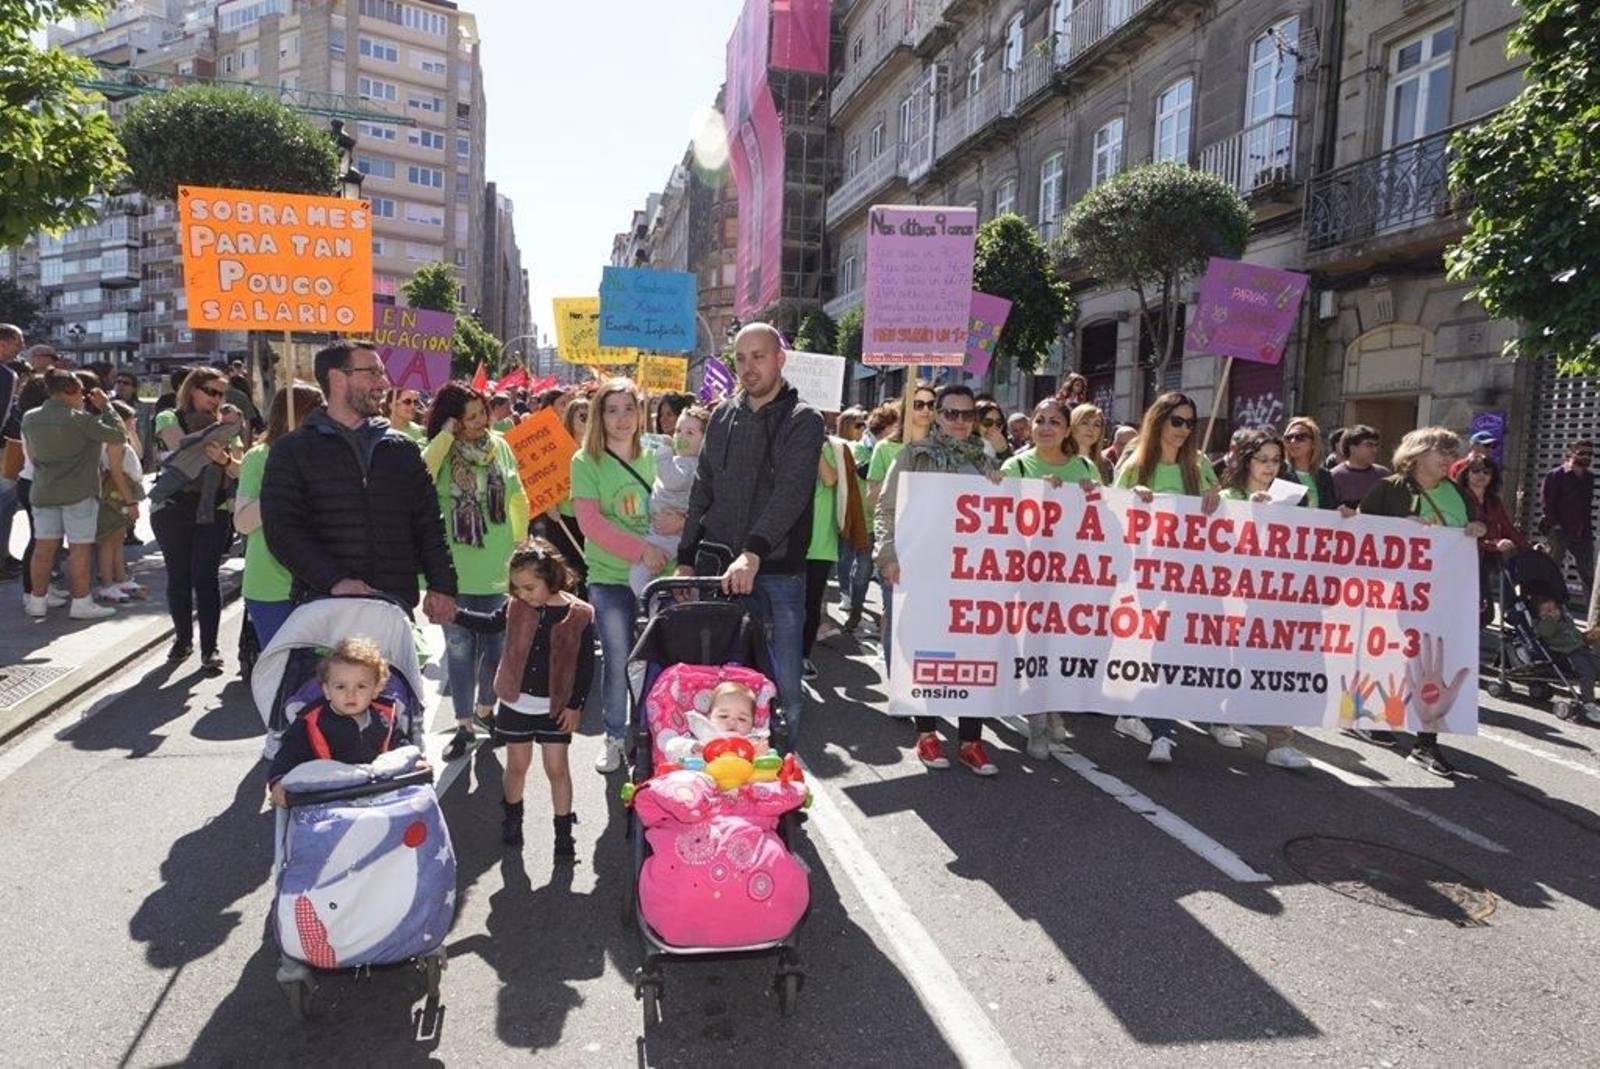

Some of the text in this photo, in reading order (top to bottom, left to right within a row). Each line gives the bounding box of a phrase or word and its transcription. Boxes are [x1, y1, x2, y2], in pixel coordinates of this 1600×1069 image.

[189, 199, 367, 230] SOBRA MES
[189, 225, 353, 259] PARA TAN
[382, 307, 418, 329] EN
[955, 493, 1433, 571] STOP Á PRECARIEDADE
[951, 547, 1431, 612] LABORAL TRABALLADORAS
[949, 595, 1421, 659] EDUCACIÓN INFANTIL 0-3
[915, 661, 996, 685] CCOO
[1013, 655, 1329, 695] POR UN CONVENIO XUSTO
[911, 685, 969, 699] ensino
